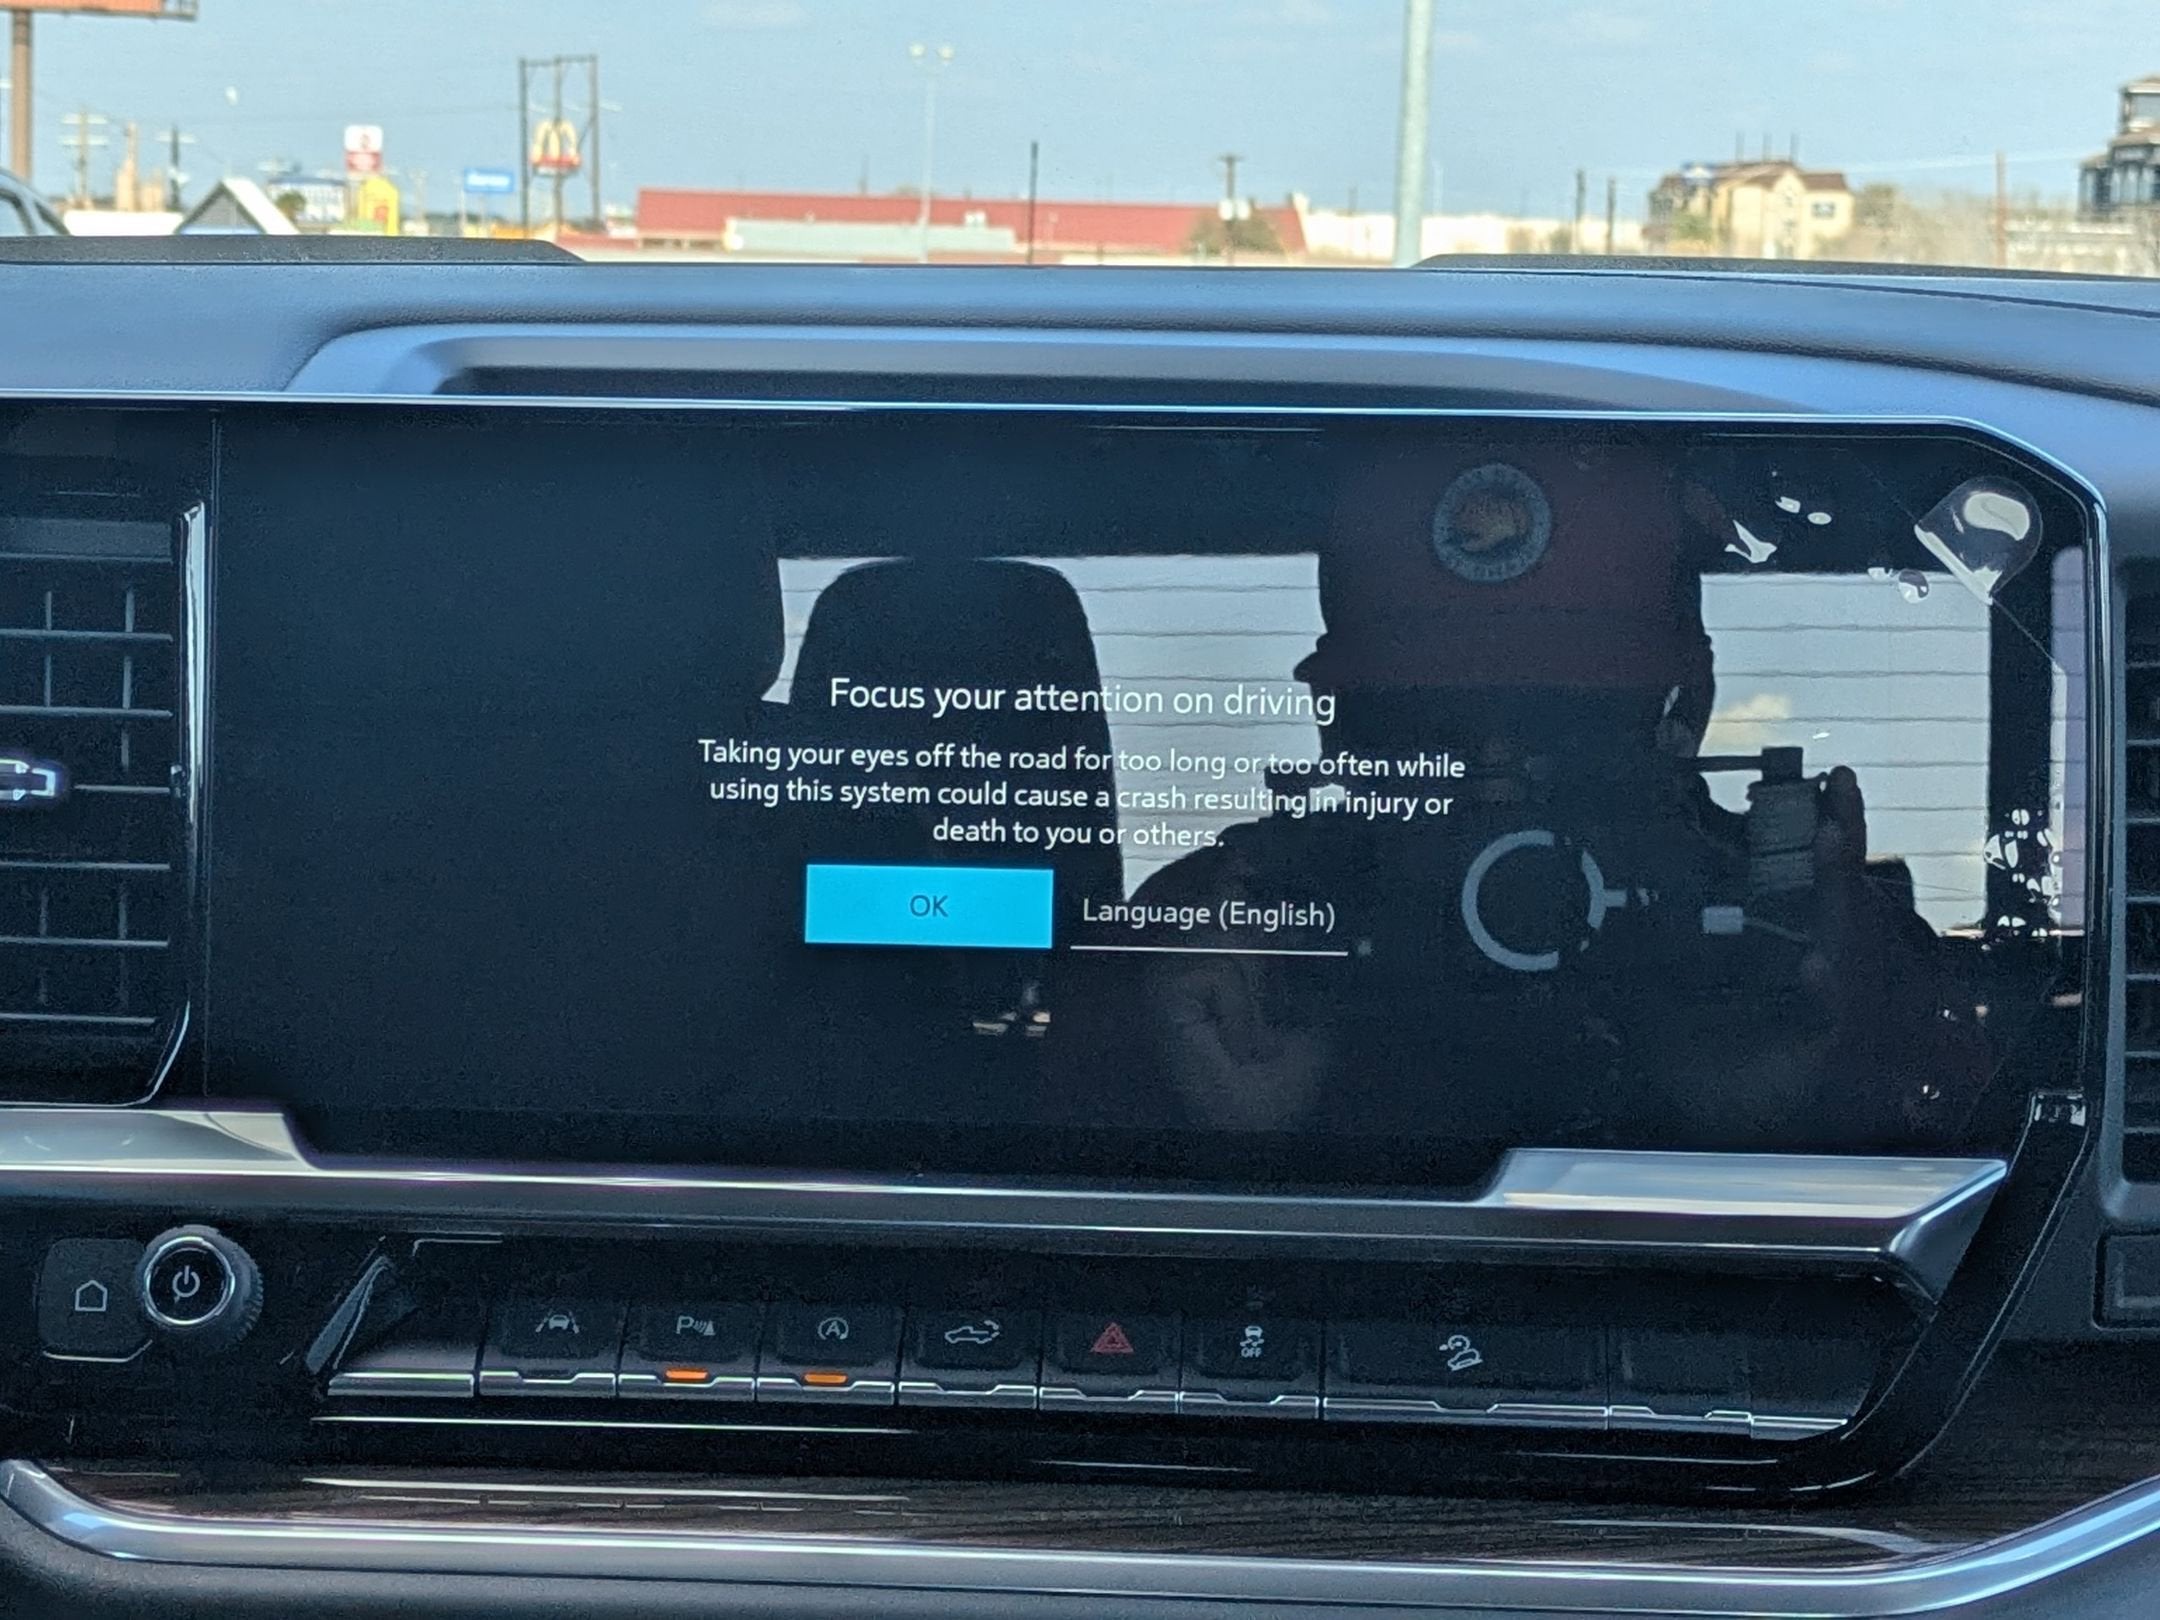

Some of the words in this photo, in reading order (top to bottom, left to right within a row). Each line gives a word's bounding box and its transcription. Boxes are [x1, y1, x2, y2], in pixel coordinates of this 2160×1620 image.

[830, 677, 926, 709] Focus
[932, 686, 1006, 718] your
[1014, 684, 1163, 714] attention
[1173, 692, 1214, 714] on
[1224, 685, 1336, 725] driving
[698, 738, 780, 770] Taking
[787, 746, 844, 774] your
[851, 748, 909, 776] eyes
[915, 742, 955, 768] off
[960, 745, 1001, 769] the
[1009, 746, 1066, 770] road
[1074, 746, 1113, 770] for
[1118, 750, 1161, 771] too
[1170, 748, 1227, 779] long
[1234, 755, 1261, 774] or
[1269, 753, 1311, 775] too
[1319, 751, 1390, 777] often
[1397, 752, 1466, 778] while
[710, 776, 779, 807] using
[786, 777, 834, 802] this
[840, 783, 930, 810] system
[937, 781, 1007, 806] could
[1014, 786, 1088, 807] cause
[1094, 790, 1109, 808] a
[1118, 785, 1186, 811] crash
[1194, 787, 1306, 818] resulting
[1313, 789, 1338, 812] in
[1345, 791, 1417, 820] injury
[1424, 795, 1453, 815] or
[932, 817, 1006, 843] death
[1012, 820, 1038, 844] to
[1045, 825, 1092, 851] you
[1099, 827, 1122, 845] or
[1133, 823, 1225, 847] others.
[909, 894, 949, 918] OK
[1082, 898, 1211, 930] Language
[1219, 900, 1336, 932] (English)
[676, 1316, 694, 1334] P
[826, 1321, 841, 1335] A
[1241, 1347, 1262, 1358] OFF
